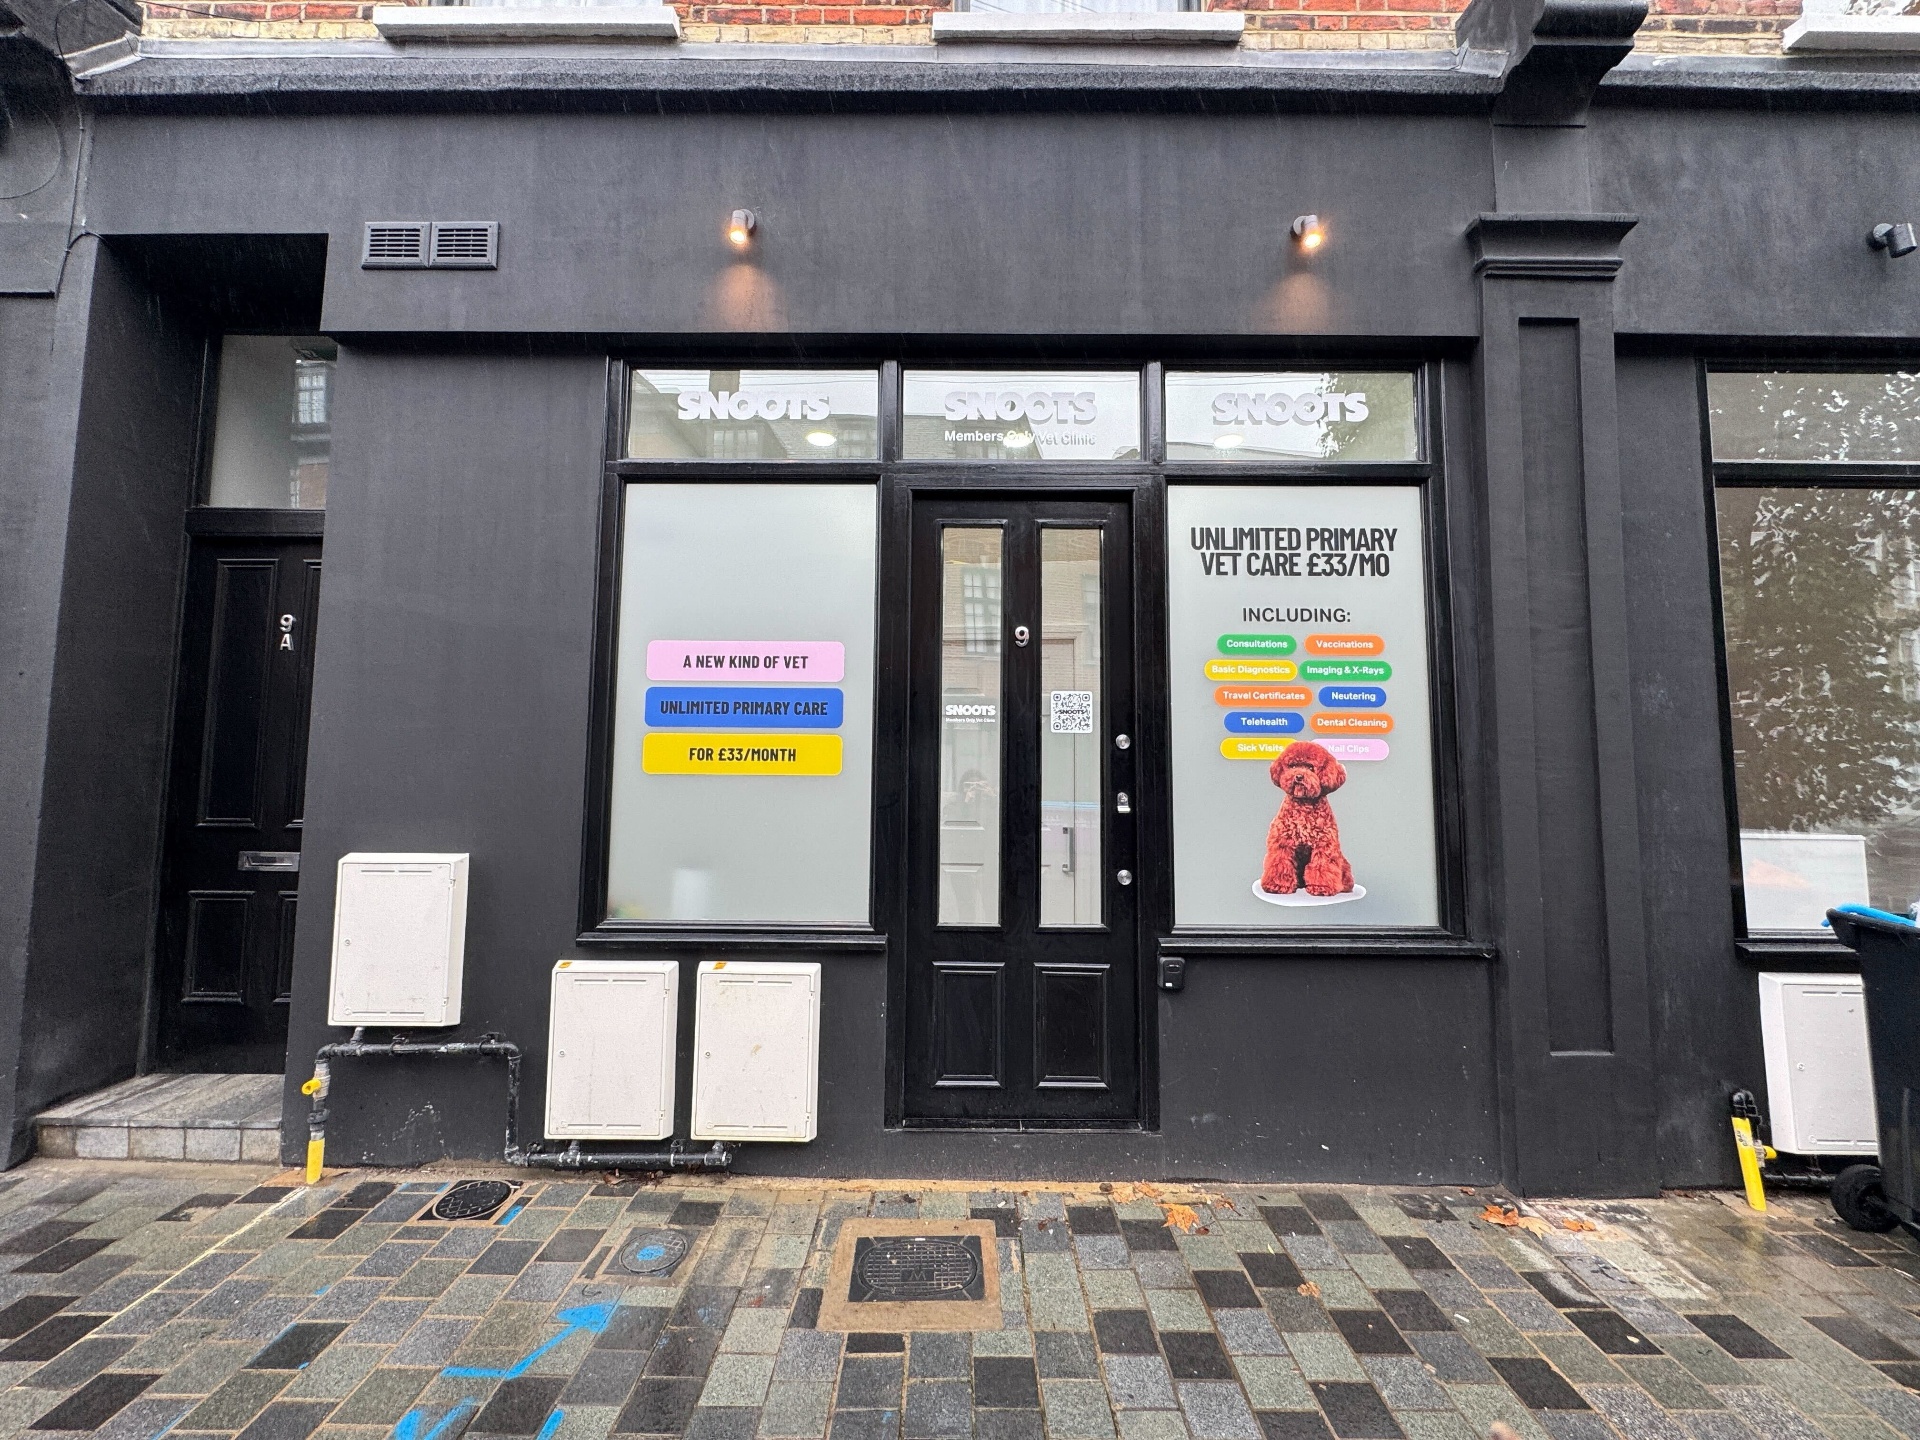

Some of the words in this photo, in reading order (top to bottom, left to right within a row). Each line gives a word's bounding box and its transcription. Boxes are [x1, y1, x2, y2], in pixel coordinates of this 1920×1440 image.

[678, 391, 830, 421] SNOOTS
[944, 391, 1098, 424] SNOOTS
[1212, 393, 1369, 424] SNOOTS
[944, 430, 1004, 442] Members
[1037, 430, 1058, 446] Vet
[1060, 430, 1097, 446] Clinic
[1190, 527, 1300, 551] UNLIMITED
[1306, 528, 1398, 551] PRIMARY
[1200, 552, 1241, 576] VET
[1246, 552, 1301, 576] CARE
[1306, 553, 1390, 577] £33/MO
[1242, 607, 1351, 622] INCLUDING:
[279, 613, 294, 633] 9
[279, 633, 295, 651] A
[1014, 625, 1030, 648] 9
[1226, 639, 1288, 648] Consultations
[1315, 639, 1374, 649] Vaccinations
[683, 654, 692, 669] A
[696, 655, 725, 669] NEW
[729, 655, 760, 669] KIND
[763, 655, 780, 669] OF
[783, 655, 809, 670] VET
[1211, 665, 1236, 674] Basic
[1237, 665, 1291, 676] Diagnostics
[1306, 665, 1343, 676] Imaging
[1343, 666, 1352, 674] &
[1352, 666, 1385, 676] X-Rays
[1222, 691, 1251, 700] Travel
[1252, 691, 1306, 700] Certificates
[1331, 691, 1376, 702] Neutering
[660, 700, 730, 715] UNLIMITED
[733, 701, 790, 716] PRIMARY
[794, 701, 829, 716] CARE
[945, 704, 996, 716] SNOOTS
[1240, 717, 1288, 726] Telehealth
[1316, 718, 1346, 727] Dental
[1347, 718, 1388, 729] Cleaning
[688, 747, 714, 761] FOR
[718, 747, 797, 762] £33/MONTH
[1237, 743, 1257, 752] Sick
[1258, 743, 1284, 752] Visits
[1328, 744, 1345, 753] Nail
[1346, 744, 1370, 755] Clips
